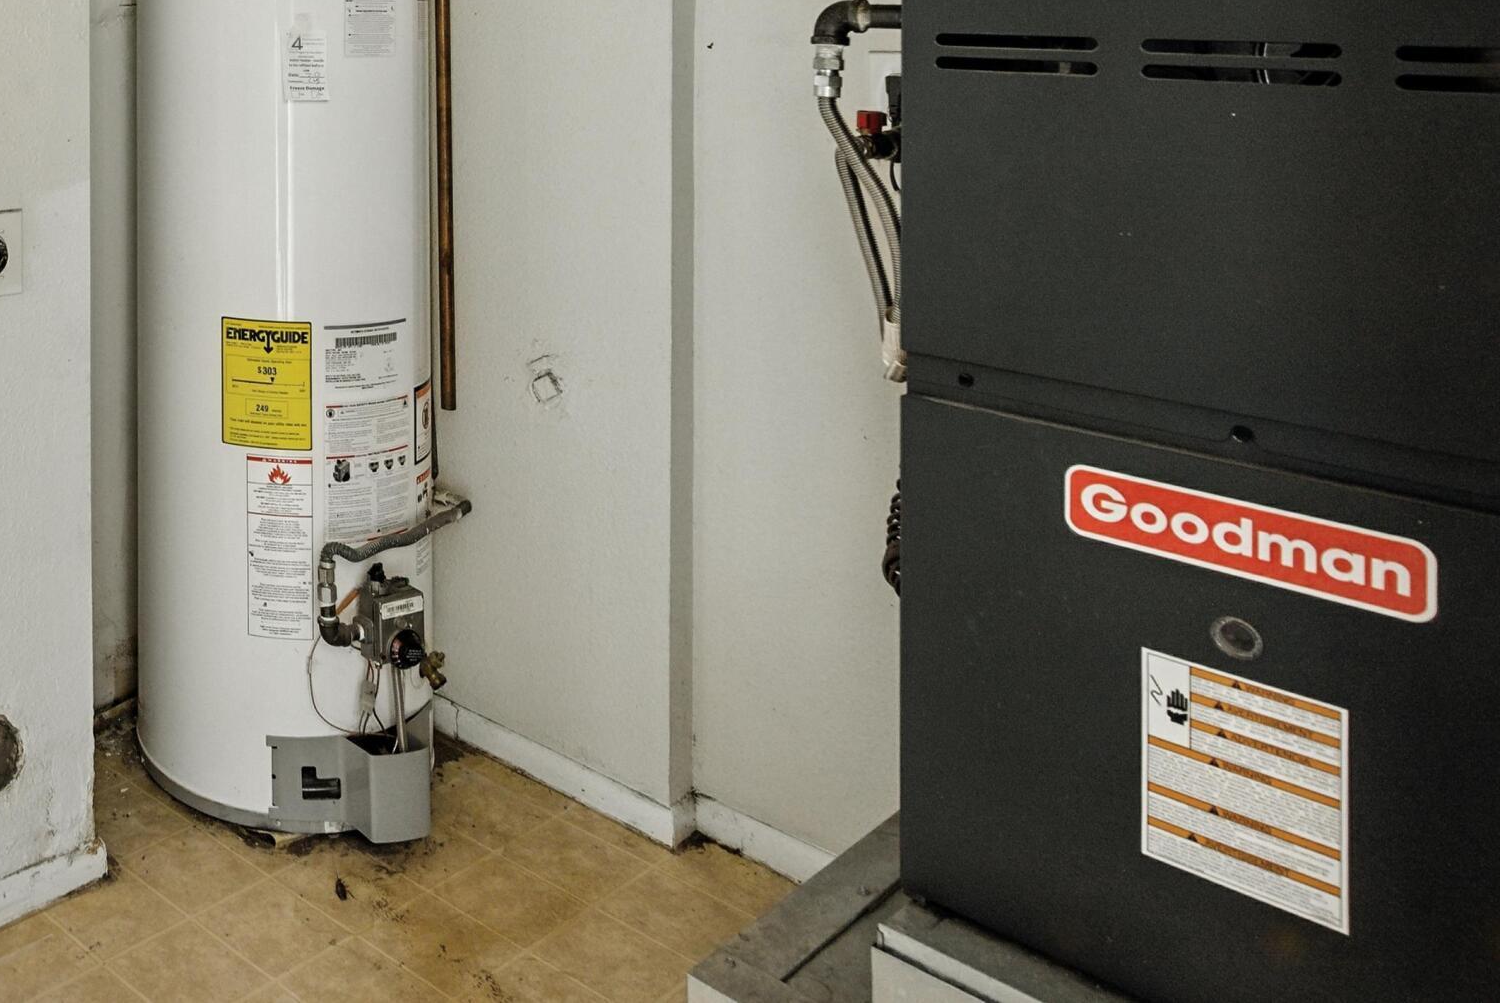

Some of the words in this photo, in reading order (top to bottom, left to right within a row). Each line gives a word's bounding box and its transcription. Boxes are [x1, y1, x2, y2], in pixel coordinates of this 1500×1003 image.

[291, 36, 303, 50] 4
[226, 327, 308, 345] ENERGYGUIDE
[1080, 483, 1411, 597] Goodman
